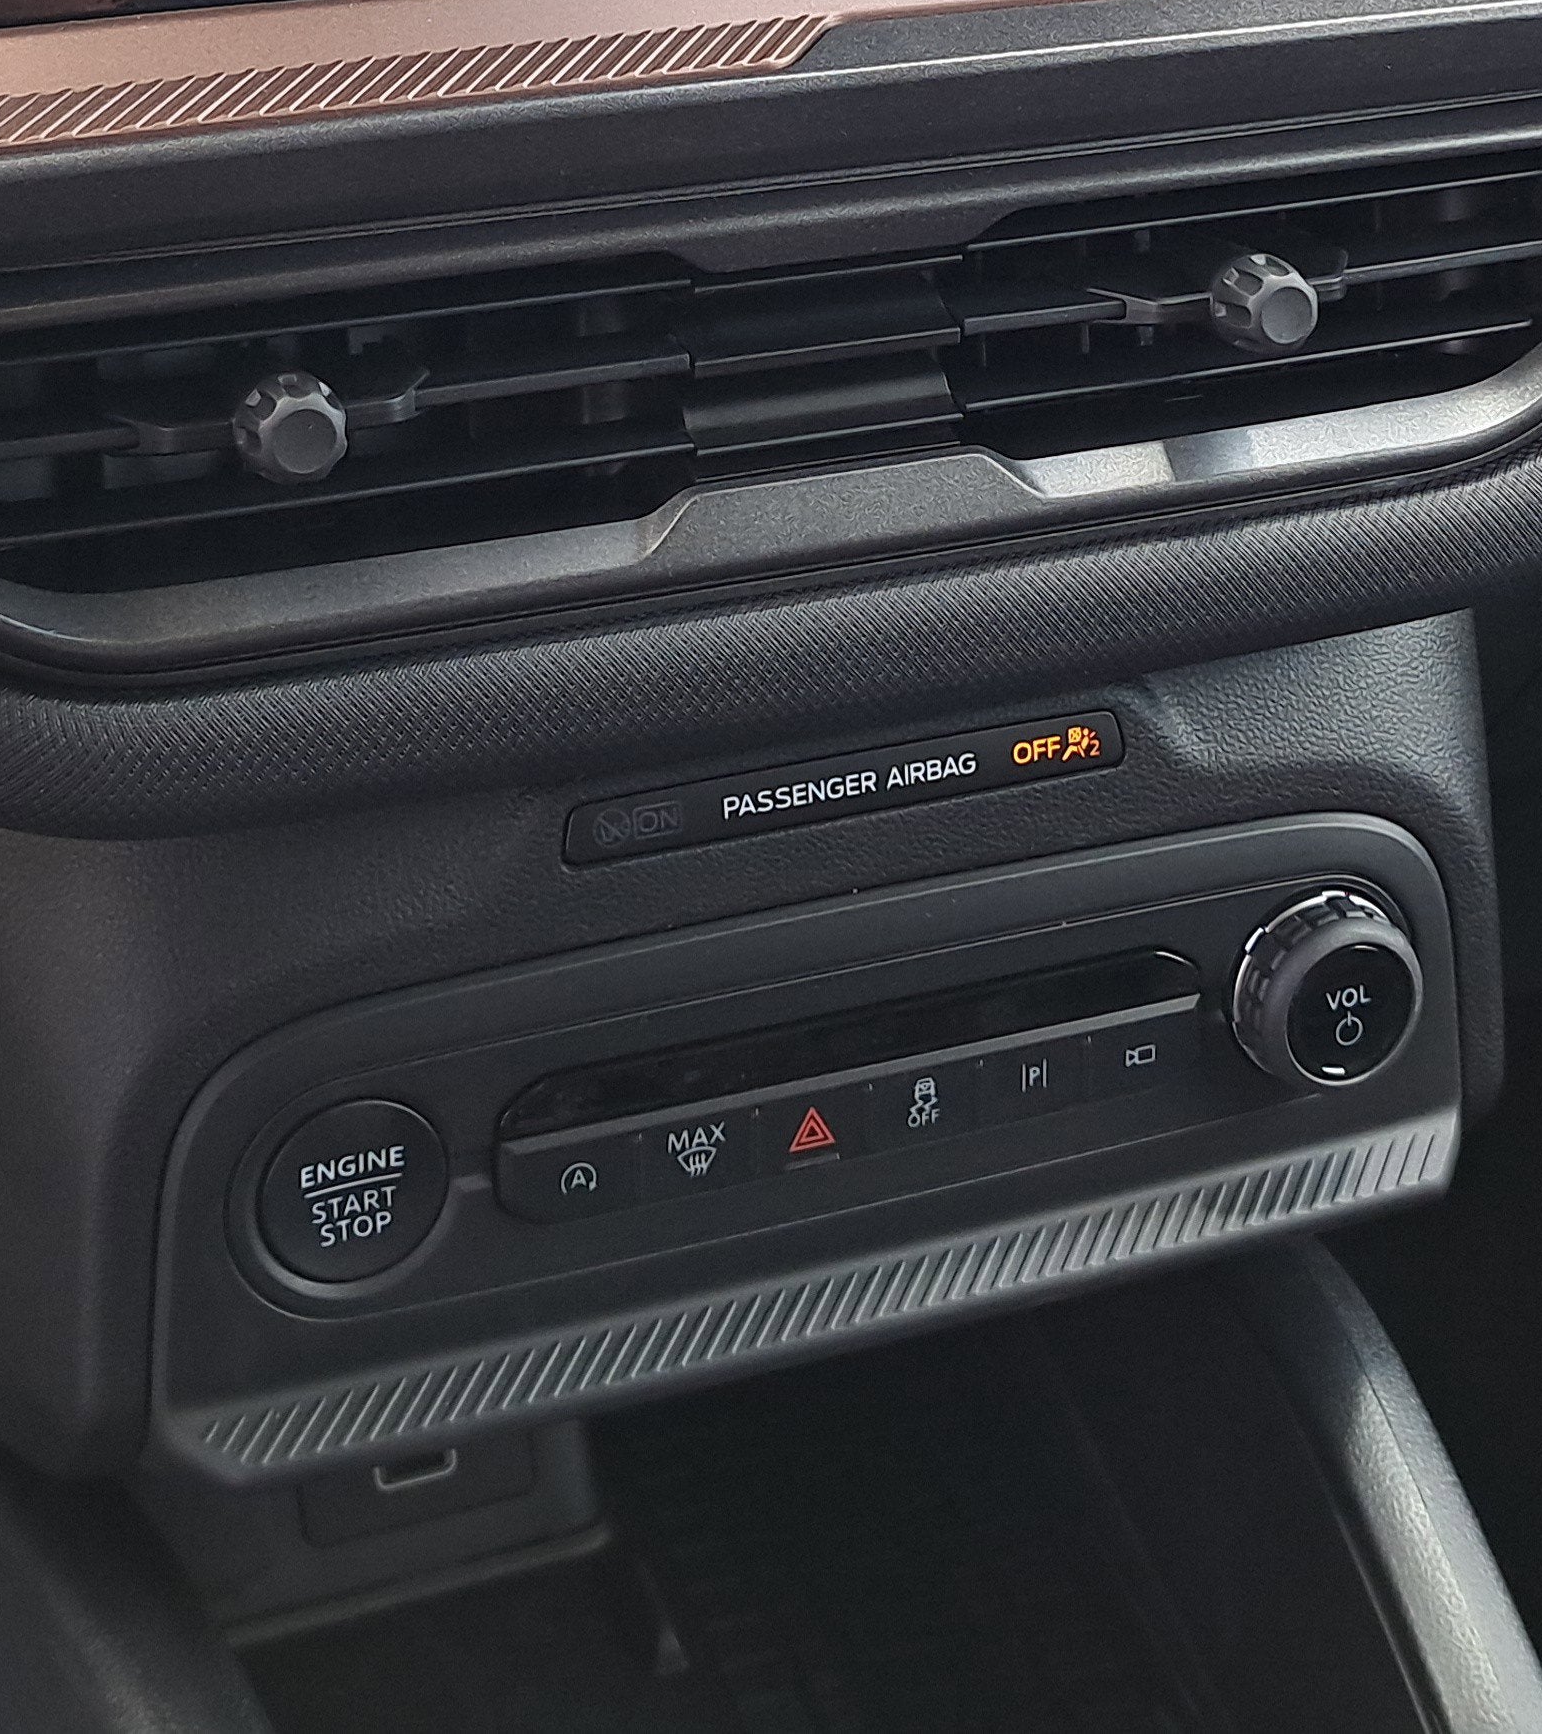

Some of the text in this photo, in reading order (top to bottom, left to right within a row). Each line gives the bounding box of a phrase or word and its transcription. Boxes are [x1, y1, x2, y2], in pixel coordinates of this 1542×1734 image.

[1013, 736, 1060, 764] OFF
[722, 752, 977, 820] PASSENGER AIRBAG
[1326, 984, 1371, 1010] VOL
[907, 1108, 940, 1128] OFF
[667, 1121, 727, 1155] MAX
[300, 1145, 405, 1189] ENGINE
[311, 1185, 397, 1224] START
[320, 1211, 392, 1248] STOP
